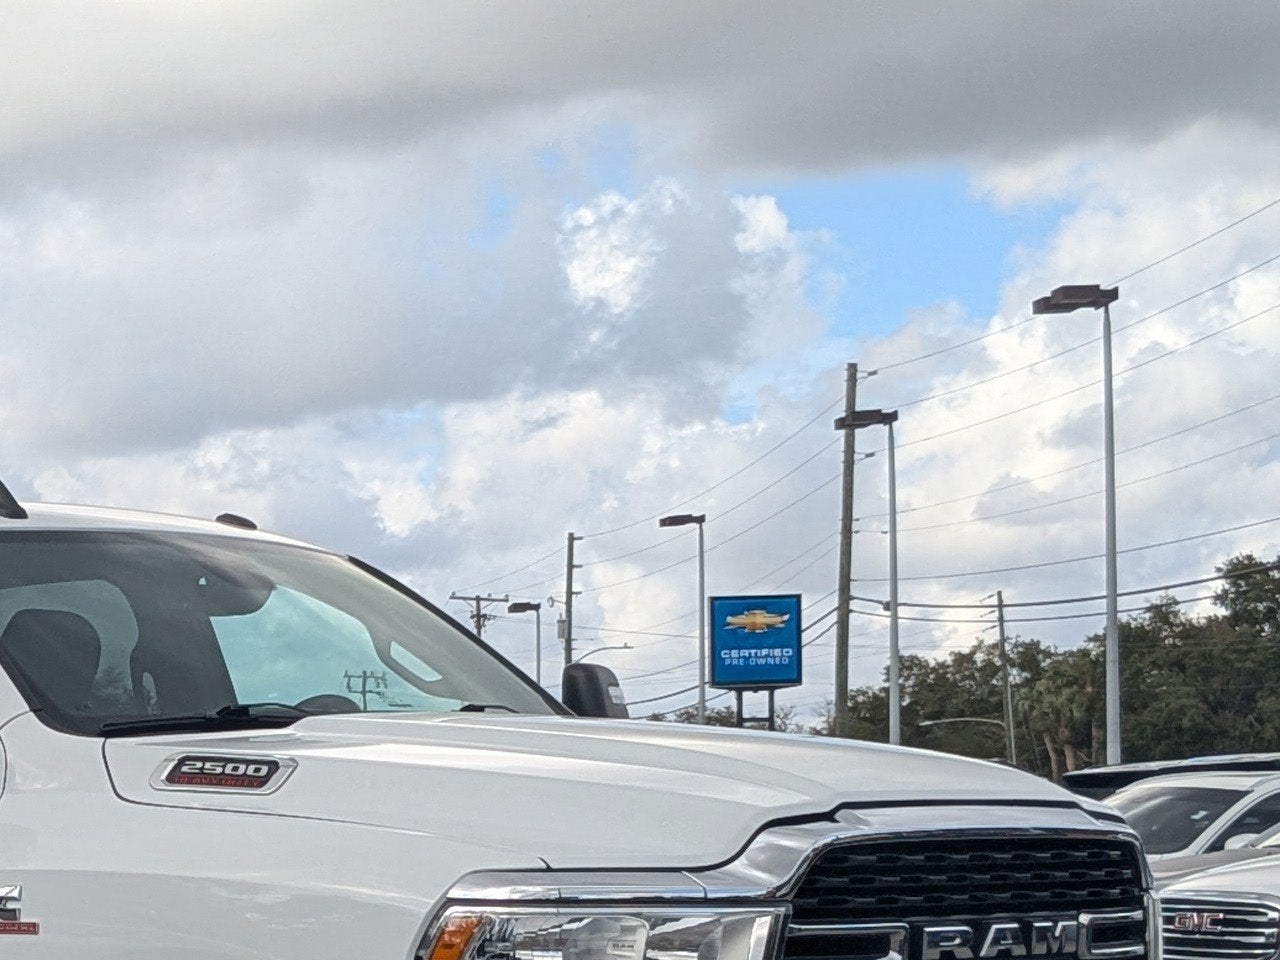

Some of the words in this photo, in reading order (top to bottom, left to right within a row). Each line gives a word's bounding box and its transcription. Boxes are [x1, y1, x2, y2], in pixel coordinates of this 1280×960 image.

[721, 648, 792, 657] CERTIFIED
[724, 657, 789, 665] PRE-OWNED
[180, 761, 269, 776] 2500
[1173, 912, 1223, 932] GMC
[922, 920, 1078, 960] RAM
